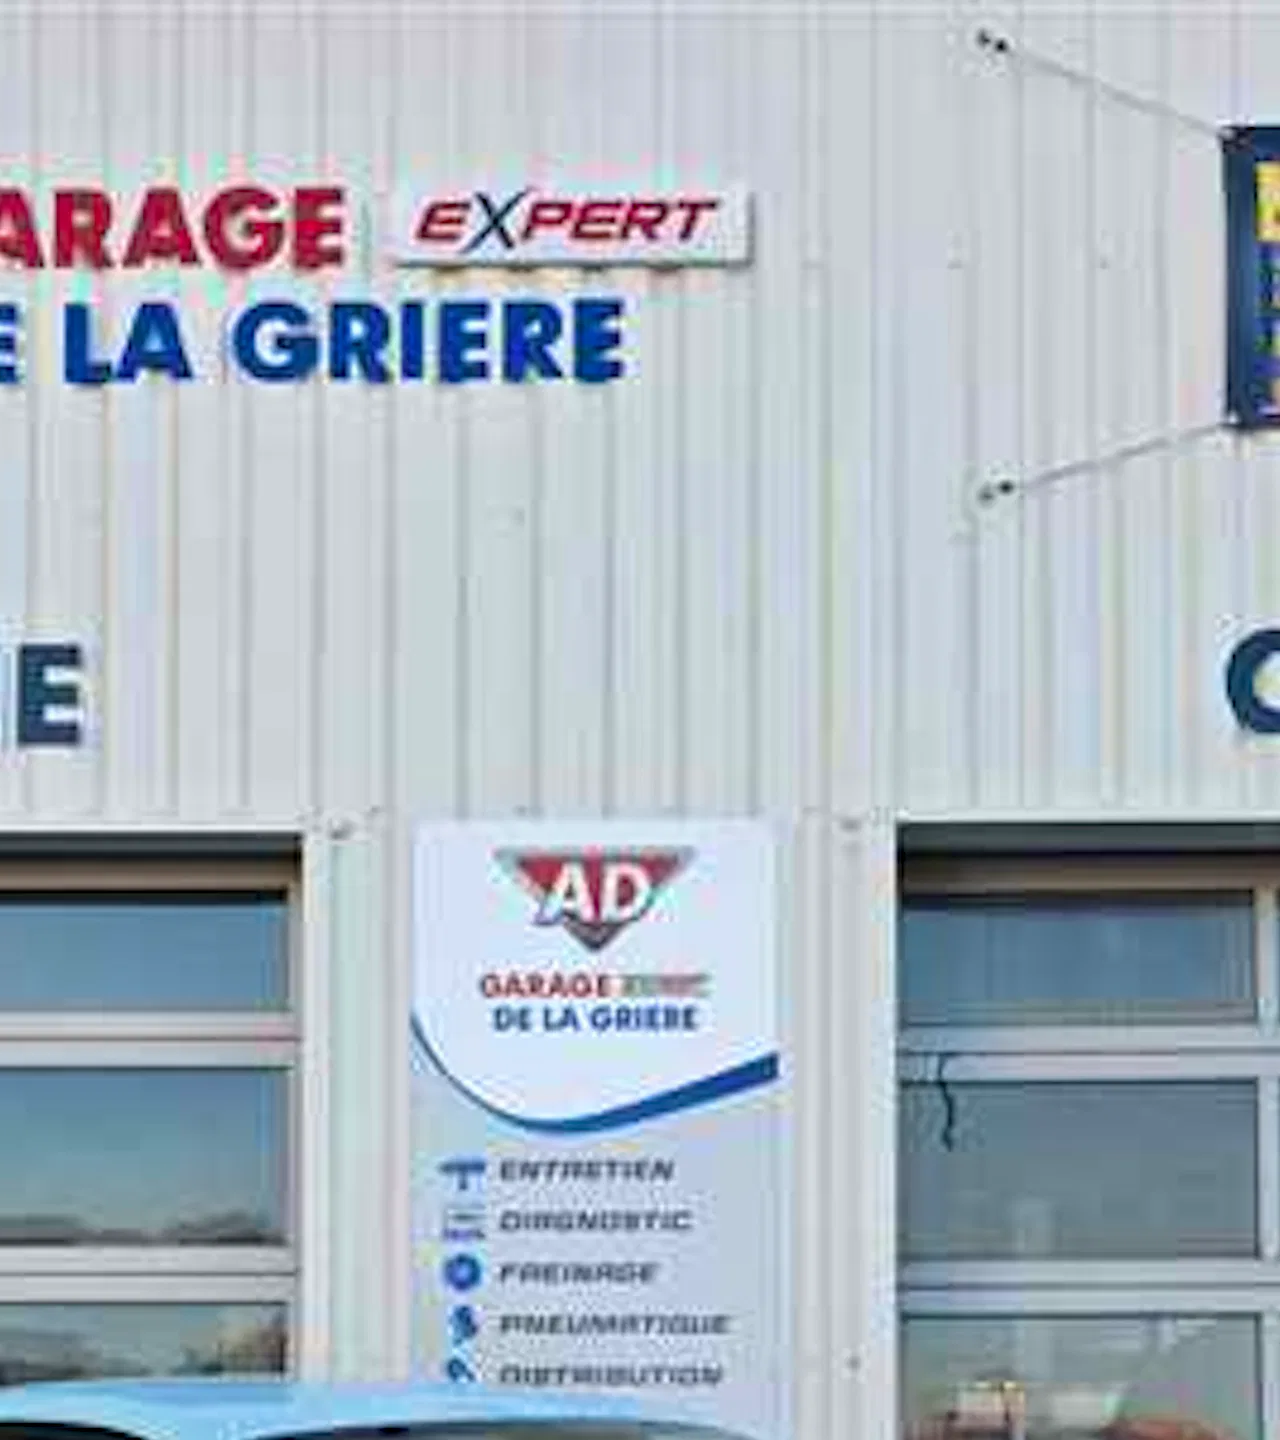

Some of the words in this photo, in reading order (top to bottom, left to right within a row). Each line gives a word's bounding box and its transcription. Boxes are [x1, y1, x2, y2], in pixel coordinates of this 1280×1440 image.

[62, 300, 193, 386] LA
[231, 297, 626, 386] GRIERE
[530, 860, 654, 926] AD
[479, 972, 611, 998] GARAGE
[492, 1004, 532, 1032] DE
[542, 1004, 581, 1032] LA
[588, 1004, 699, 1032] GRIERE
[498, 1159, 676, 1182] ENTRETIEN
[497, 1208, 696, 1232] DIAGNOSTIC
